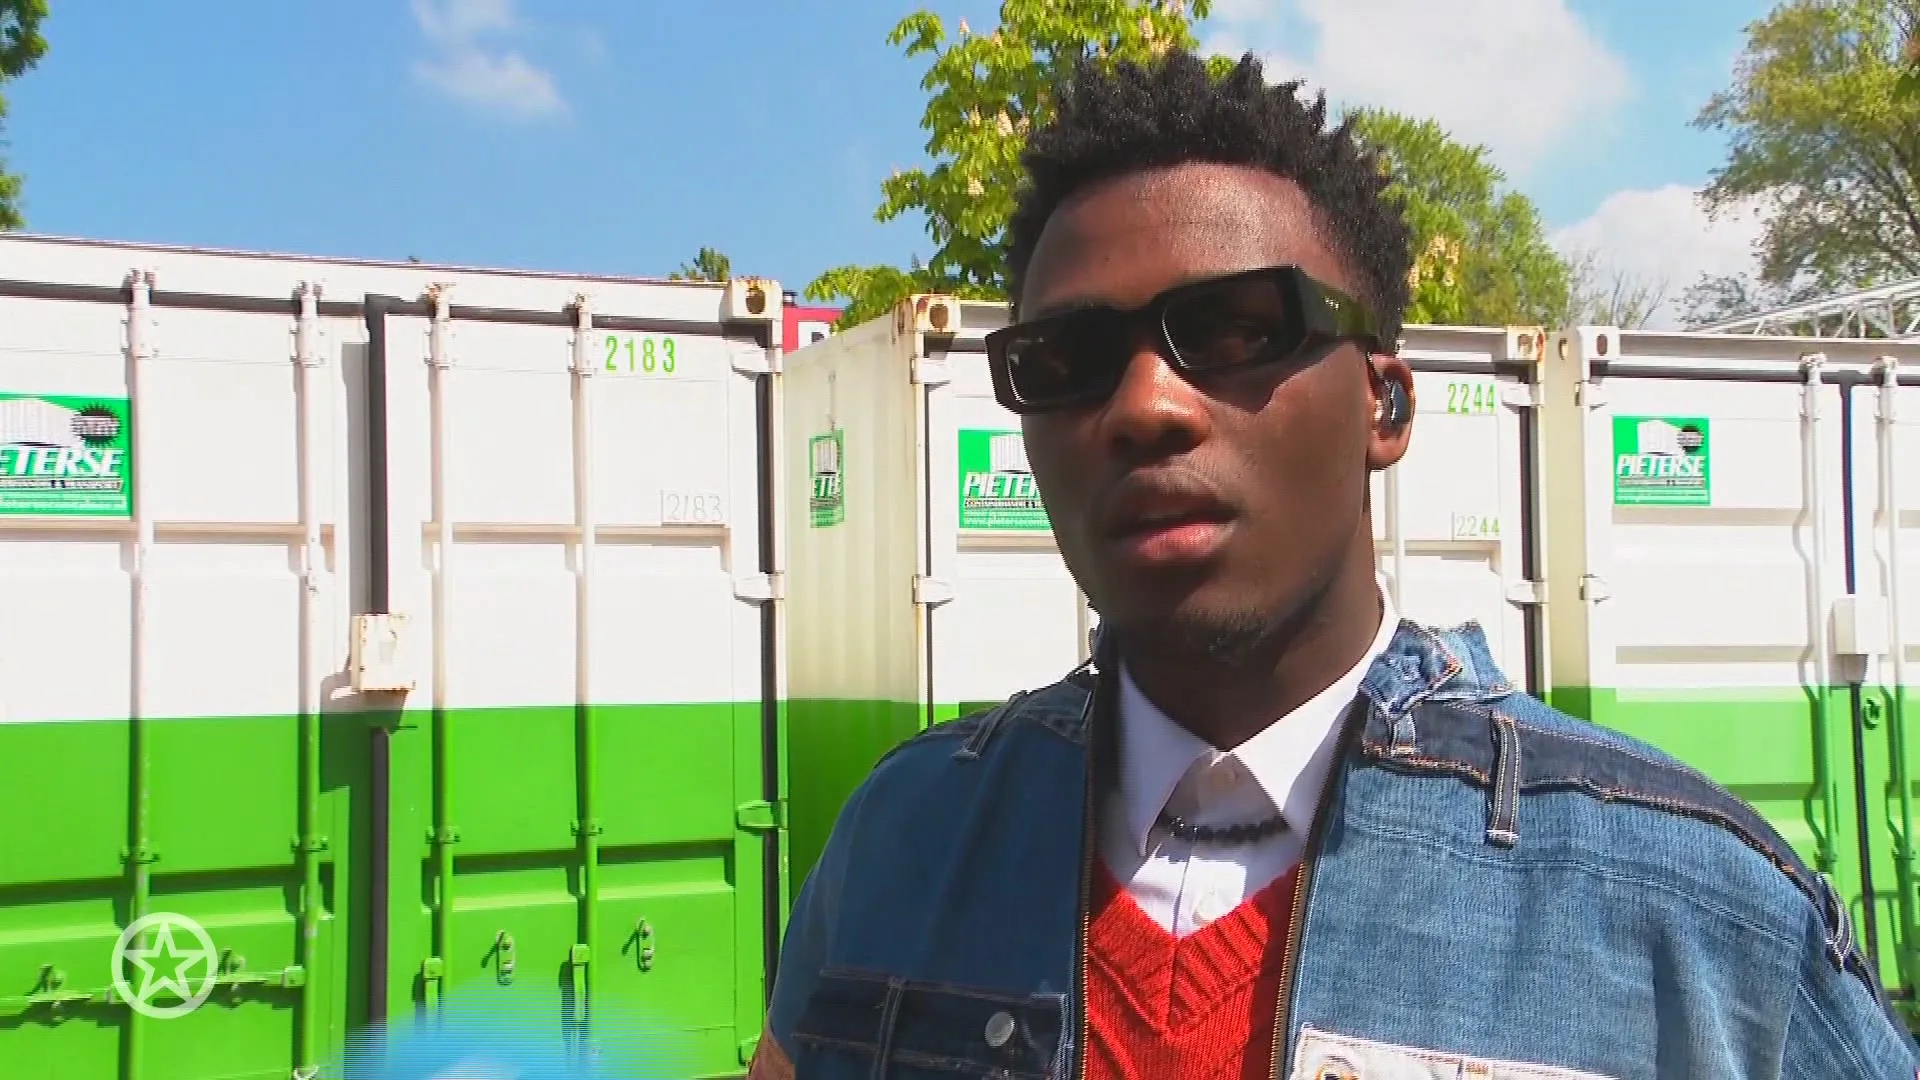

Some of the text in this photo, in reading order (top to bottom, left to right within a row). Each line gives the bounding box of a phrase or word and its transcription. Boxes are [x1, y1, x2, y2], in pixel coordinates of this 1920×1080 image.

[604, 335, 676, 374] 2183
[1447, 383, 1495, 415] 2244
[1615, 454, 1707, 477] PIETERSE
[665, 492, 723, 523] 2183
[1455, 515, 1501, 538] 2244
